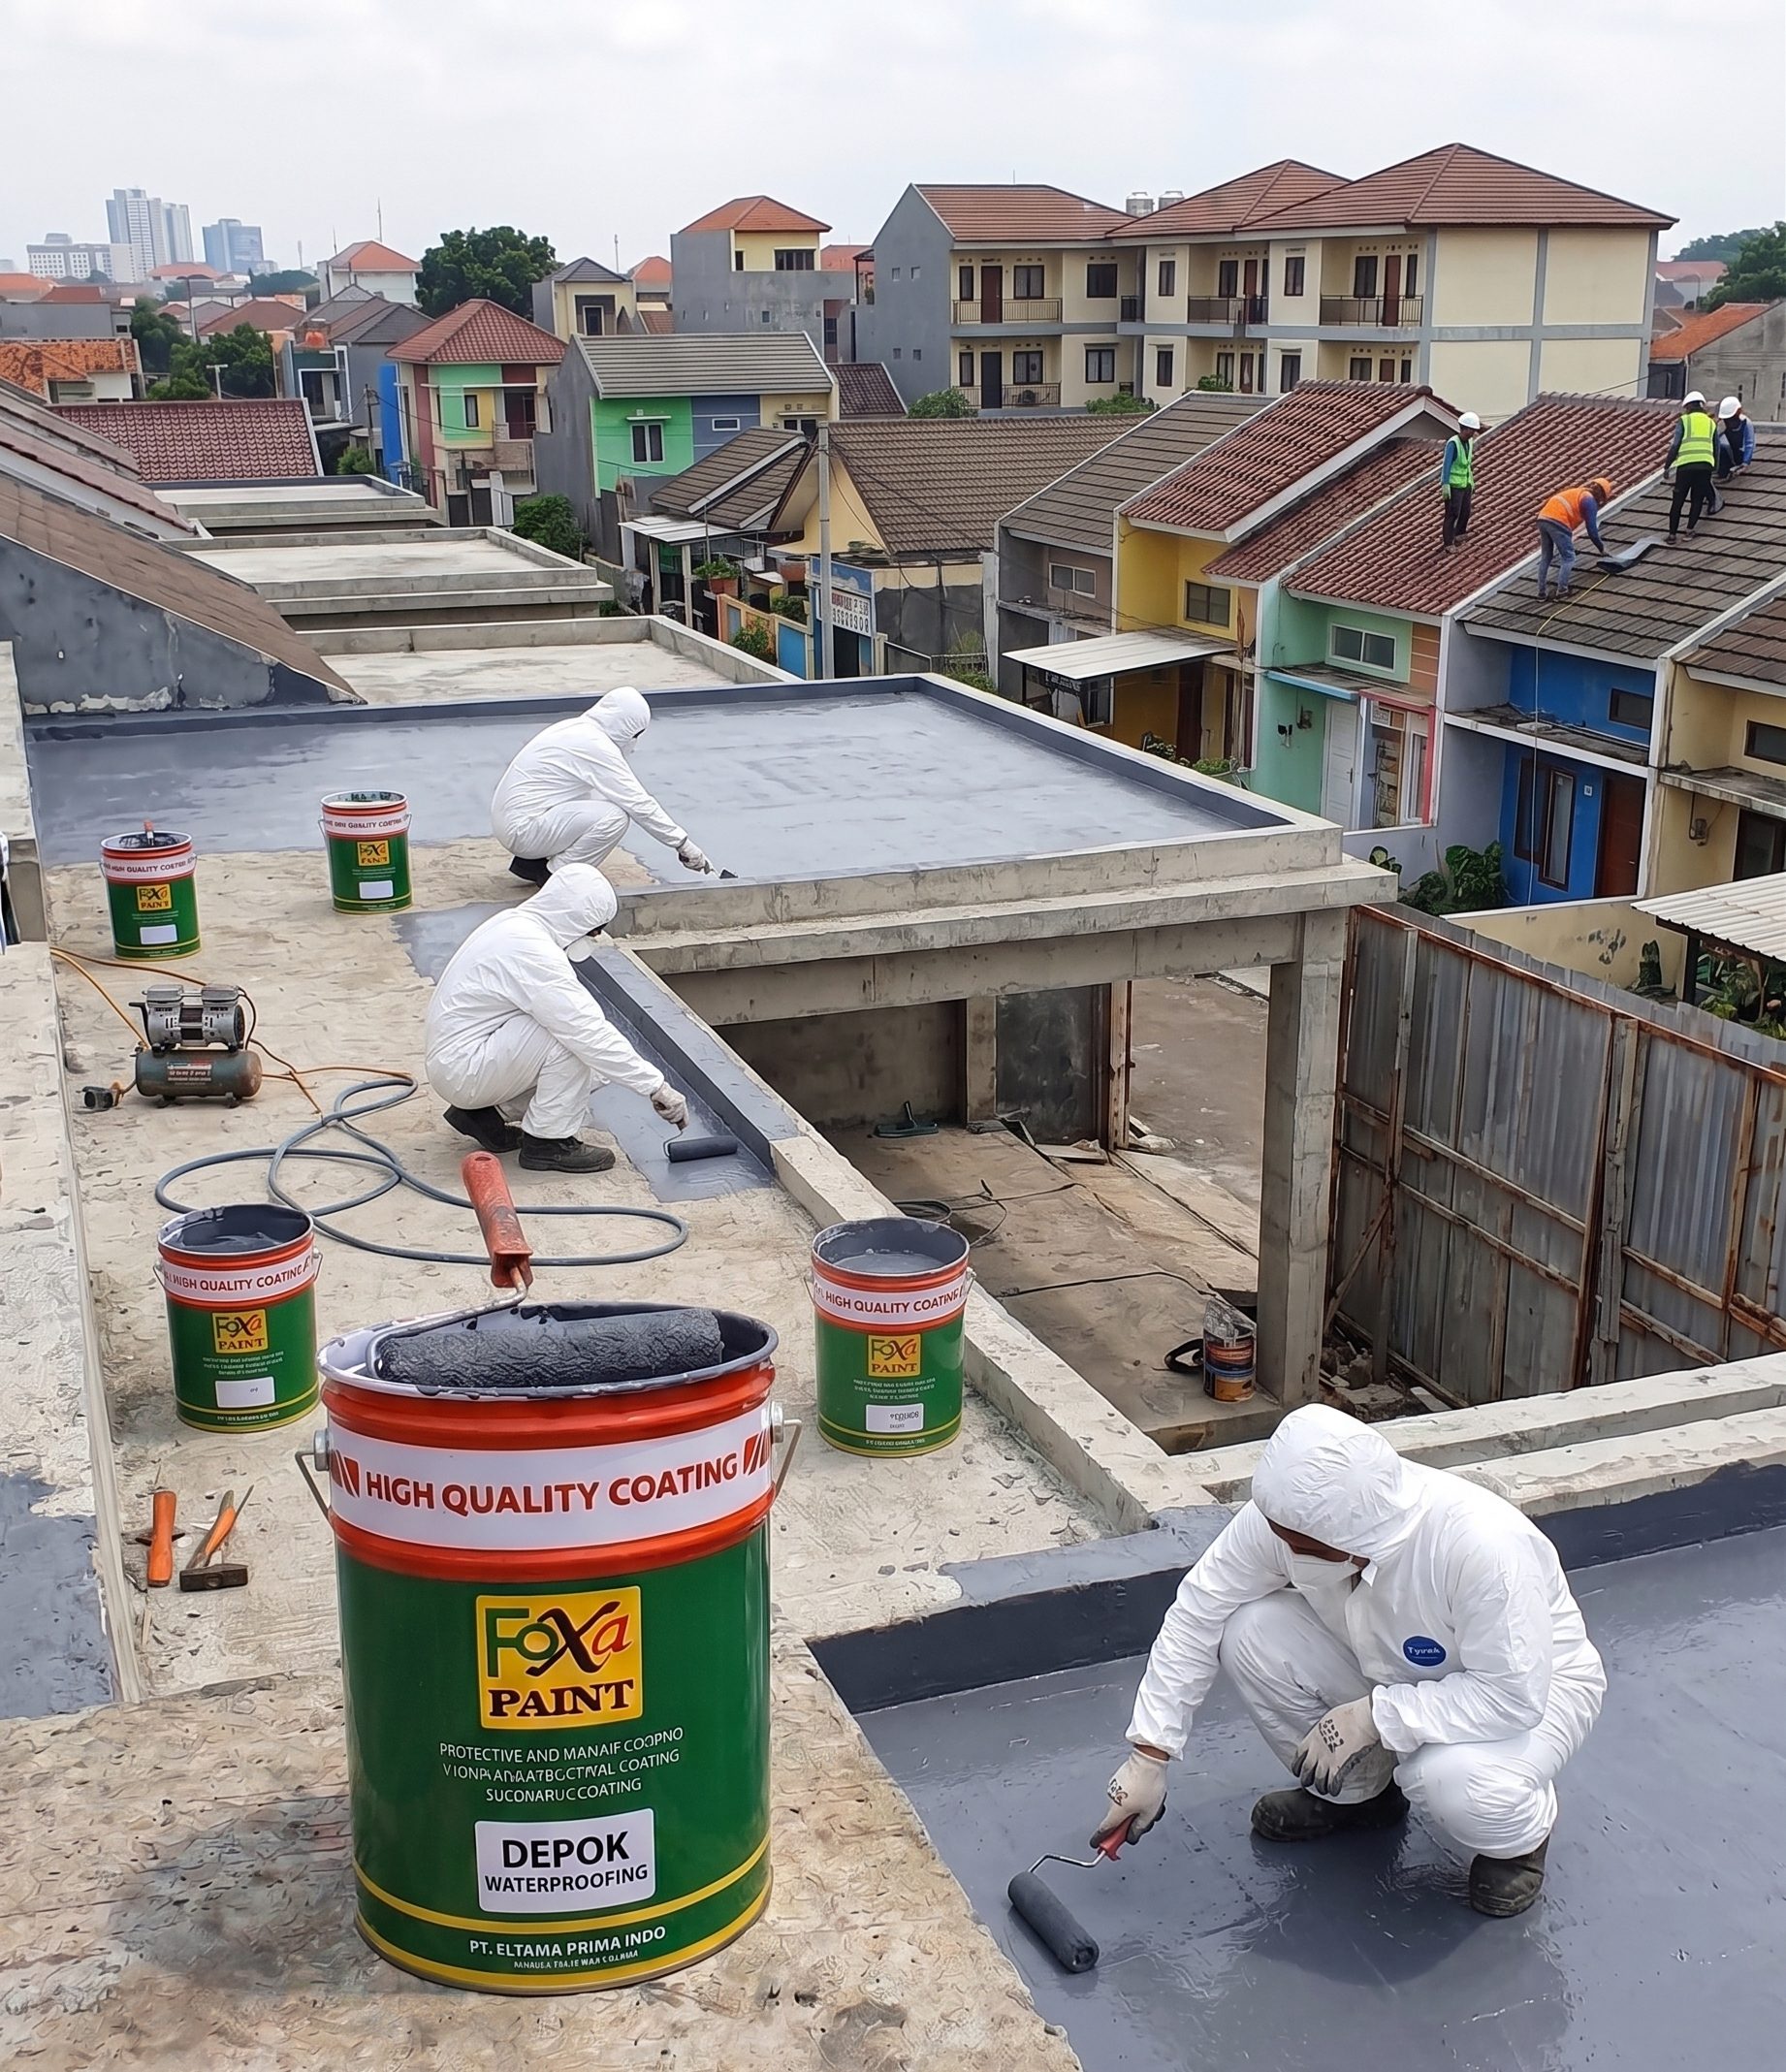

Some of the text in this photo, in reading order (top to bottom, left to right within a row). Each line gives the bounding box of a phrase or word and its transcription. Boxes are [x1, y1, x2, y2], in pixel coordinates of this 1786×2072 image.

[200, 1278, 253, 1291] QUALITY
[825, 1291, 851, 1309] HIGH
[853, 1300, 910, 1314] QUALITY
[218, 1337, 266, 1351] PAINT
[871, 1362, 917, 1373] PAINT
[366, 1452, 737, 1517] HIGH QUALITY COATING
[488, 1678, 634, 1718] PAINT
[439, 1742, 524, 1764] PROTECTIVE
[526, 1748, 560, 1763] AND
[619, 1748, 680, 1773] COATING
[502, 1831, 629, 1869] DEPOK
[485, 1864, 648, 1893] WATERPROOFING
[469, 1926, 666, 1958] PT. ELTAMA PRIMA INDO
